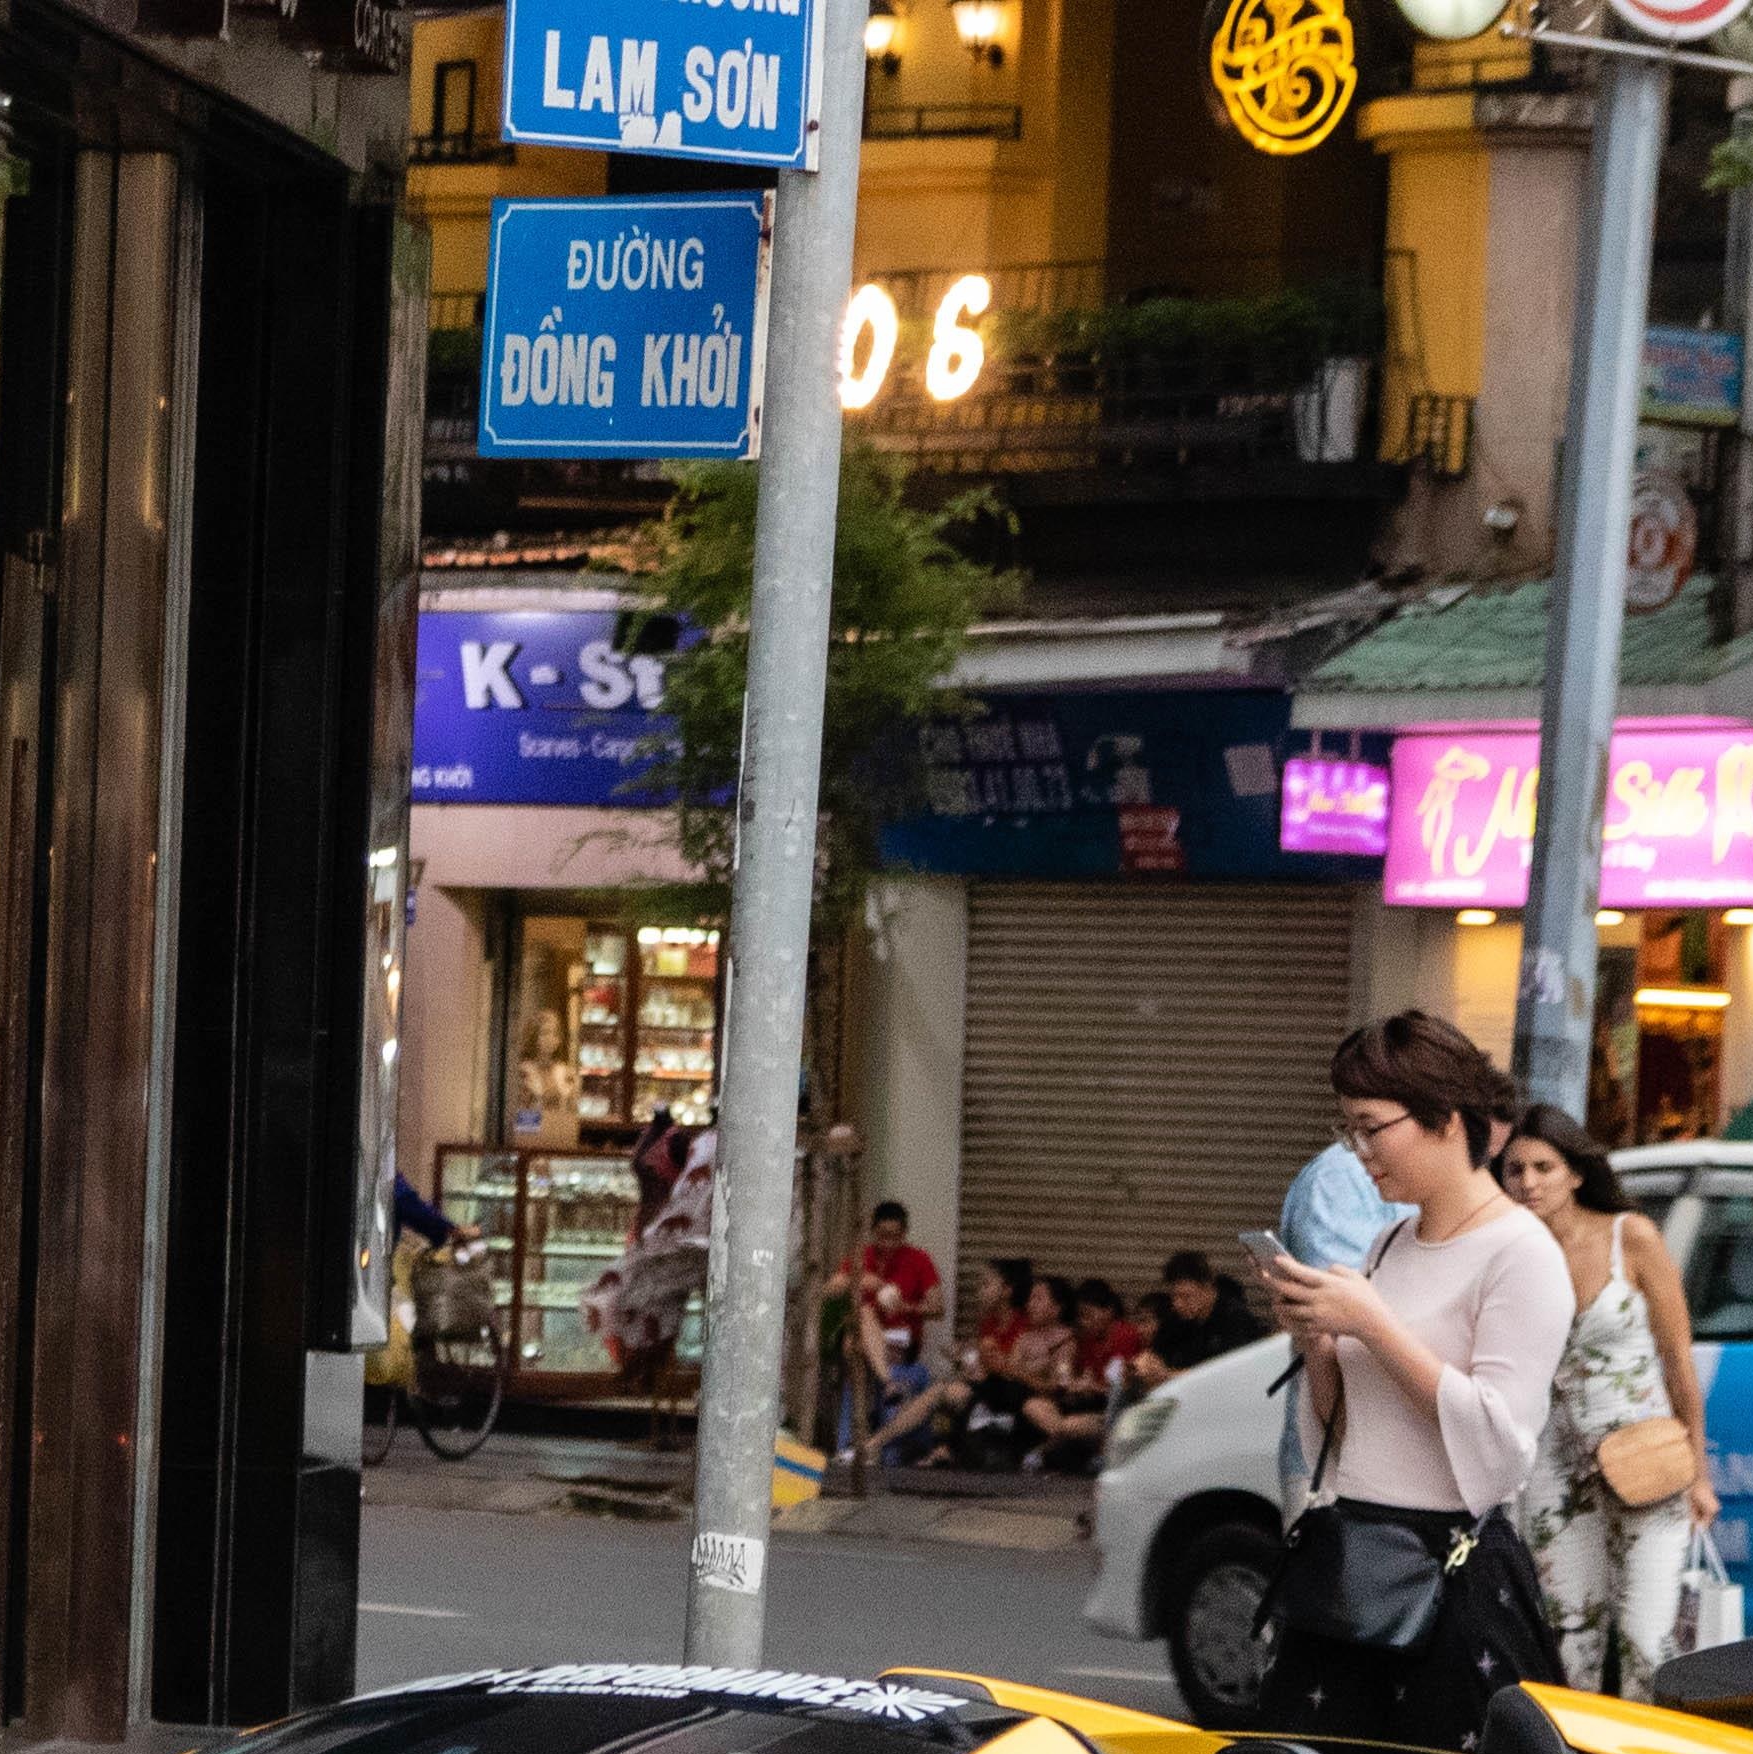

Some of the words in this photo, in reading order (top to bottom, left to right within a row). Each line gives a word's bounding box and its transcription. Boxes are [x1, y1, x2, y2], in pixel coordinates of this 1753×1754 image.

[543, 29, 658, 117] LAM
[682, 37, 781, 131] SƠN
[566, 225, 705, 292] ĐƯỜNG
[499, 305, 617, 409] ĐỒNG
[640, 302, 744, 410] KHỞI
